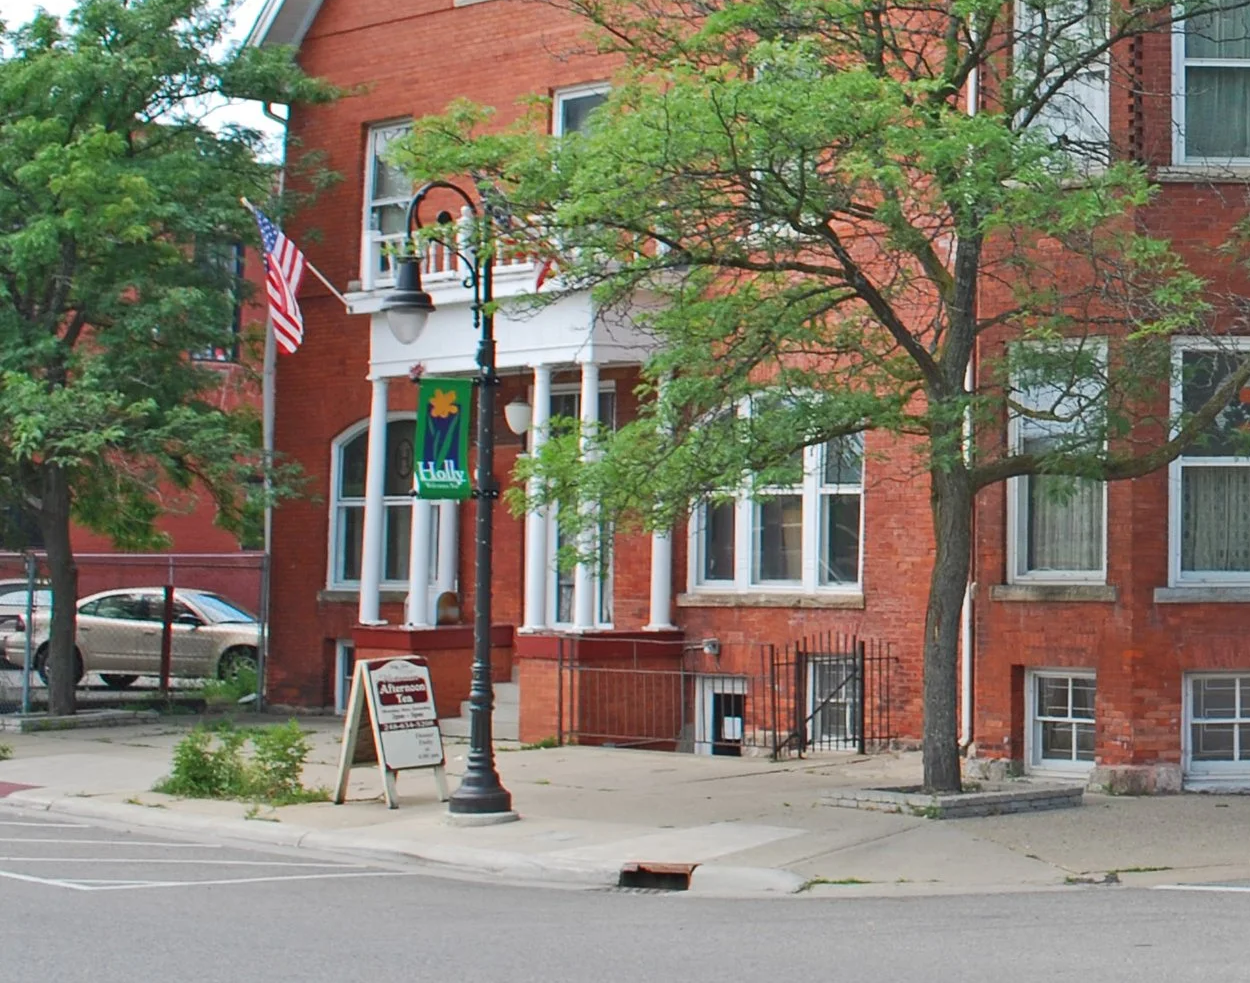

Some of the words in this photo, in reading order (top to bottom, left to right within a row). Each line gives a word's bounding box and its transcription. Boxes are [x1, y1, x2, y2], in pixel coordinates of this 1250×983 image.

[417, 459, 465, 485] Holly
[380, 683, 426, 694] Afternoon
[395, 693, 414, 704] Tea
